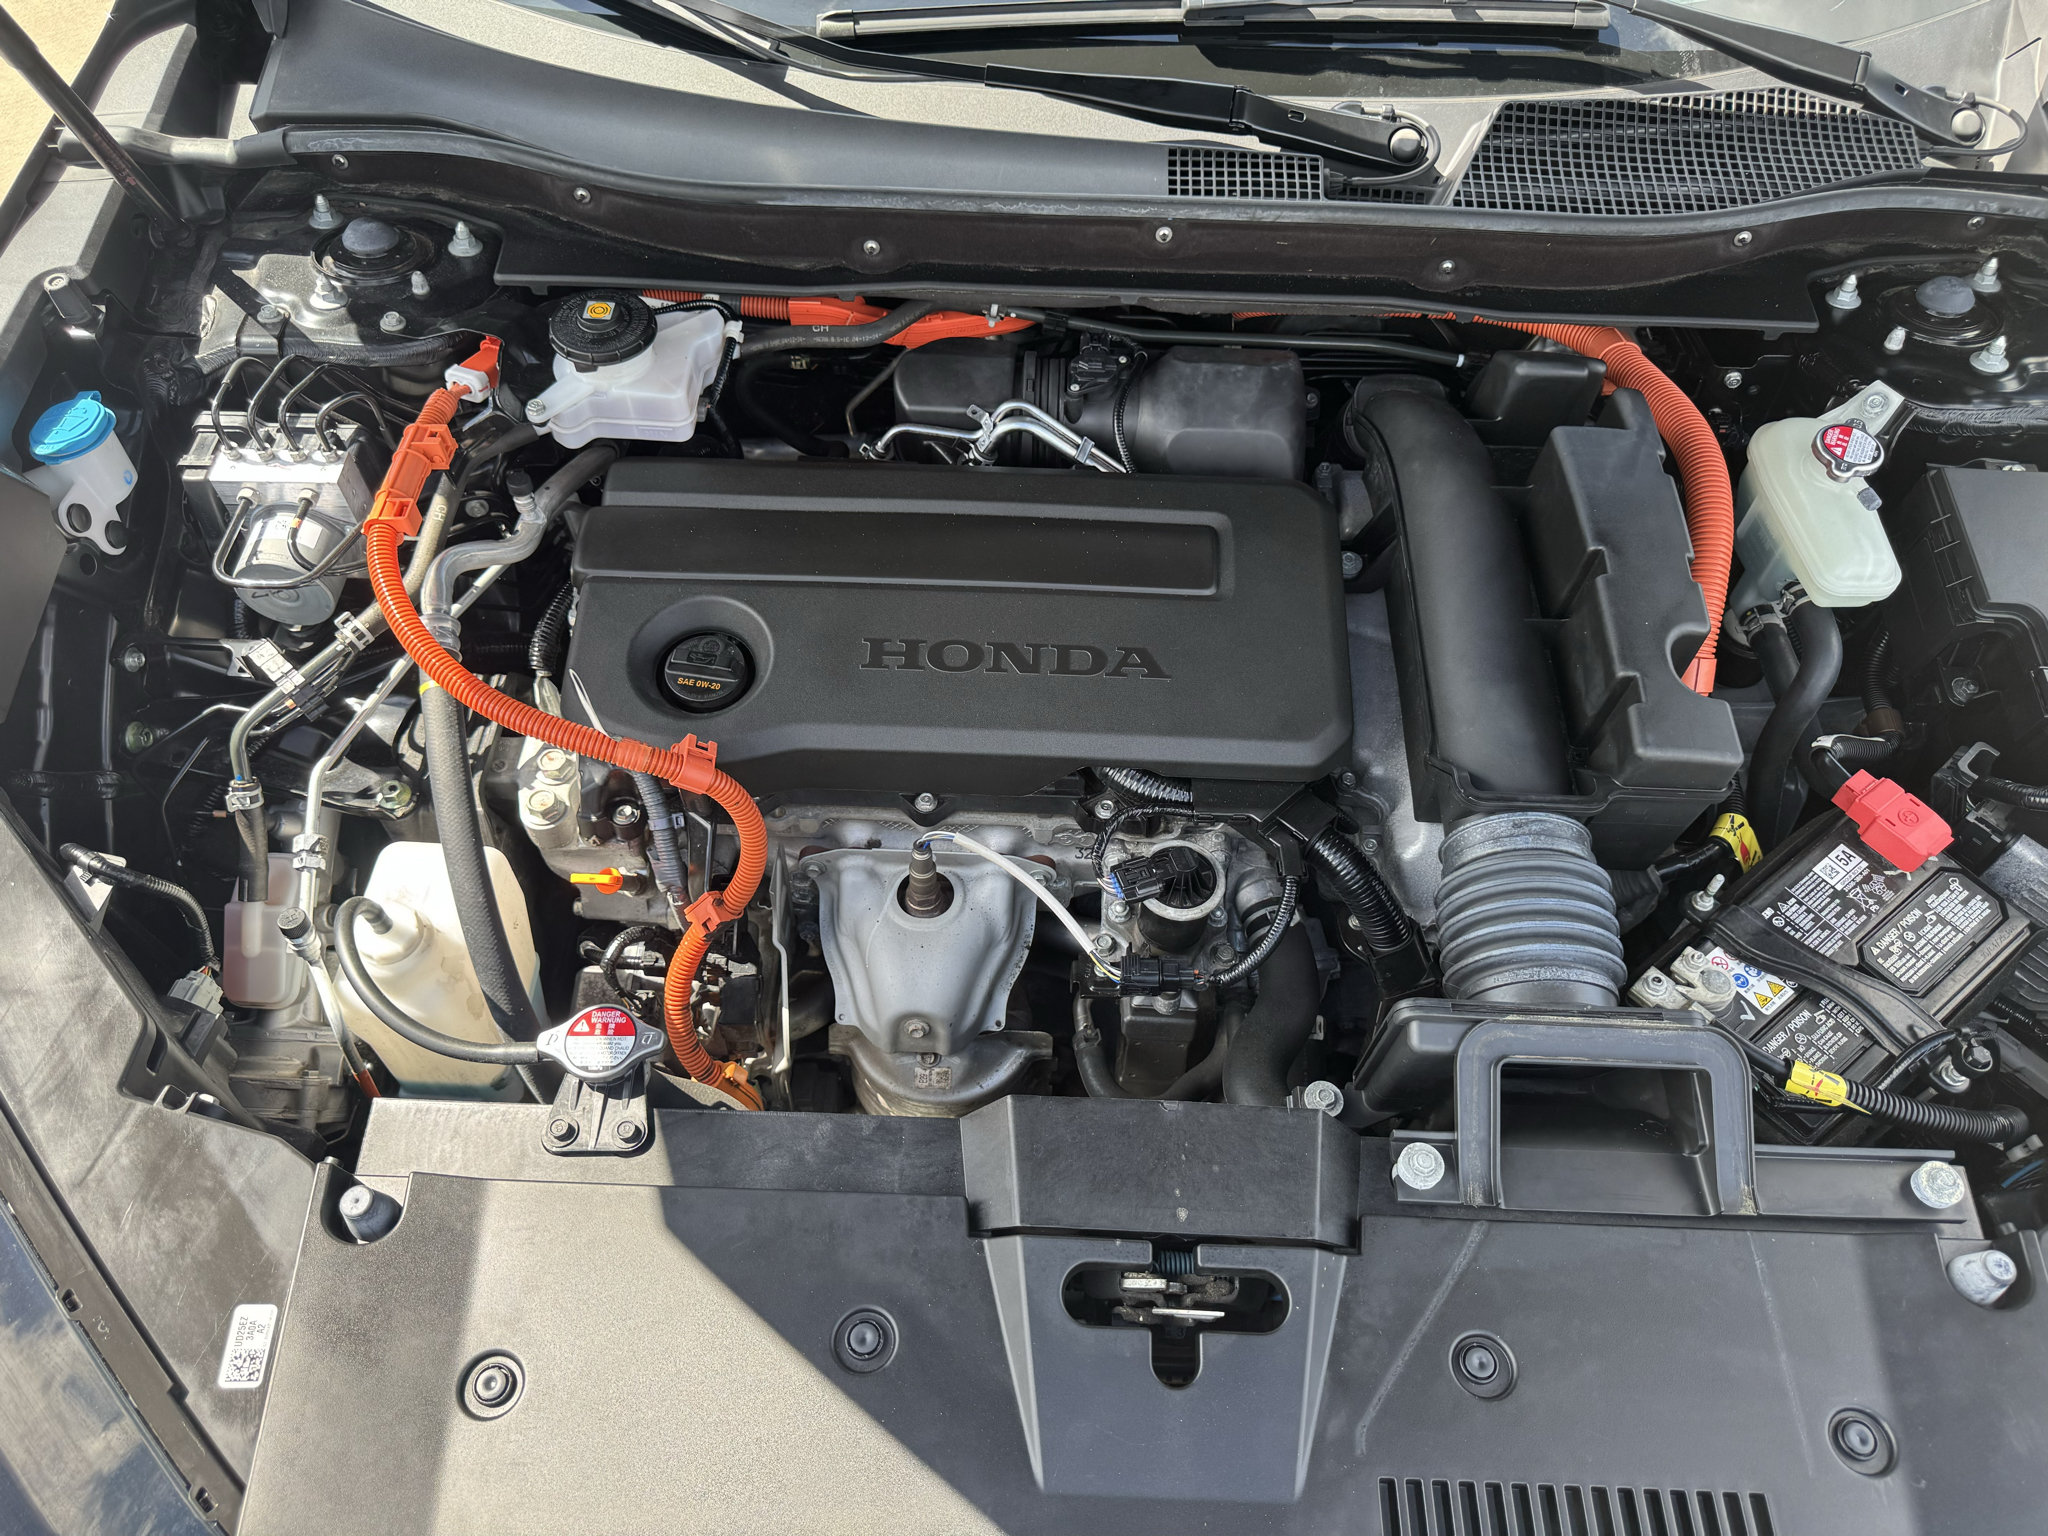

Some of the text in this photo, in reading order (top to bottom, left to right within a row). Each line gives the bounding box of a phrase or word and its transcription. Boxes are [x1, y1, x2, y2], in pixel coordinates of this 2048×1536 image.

[859, 637, 1172, 681] HONDA
[677, 677, 721, 690] SAE 0W-20
[1835, 850, 1857, 867] 5A
[234, 1316, 248, 1347] UD25EZ
[256, 1323, 267, 1334] A2
